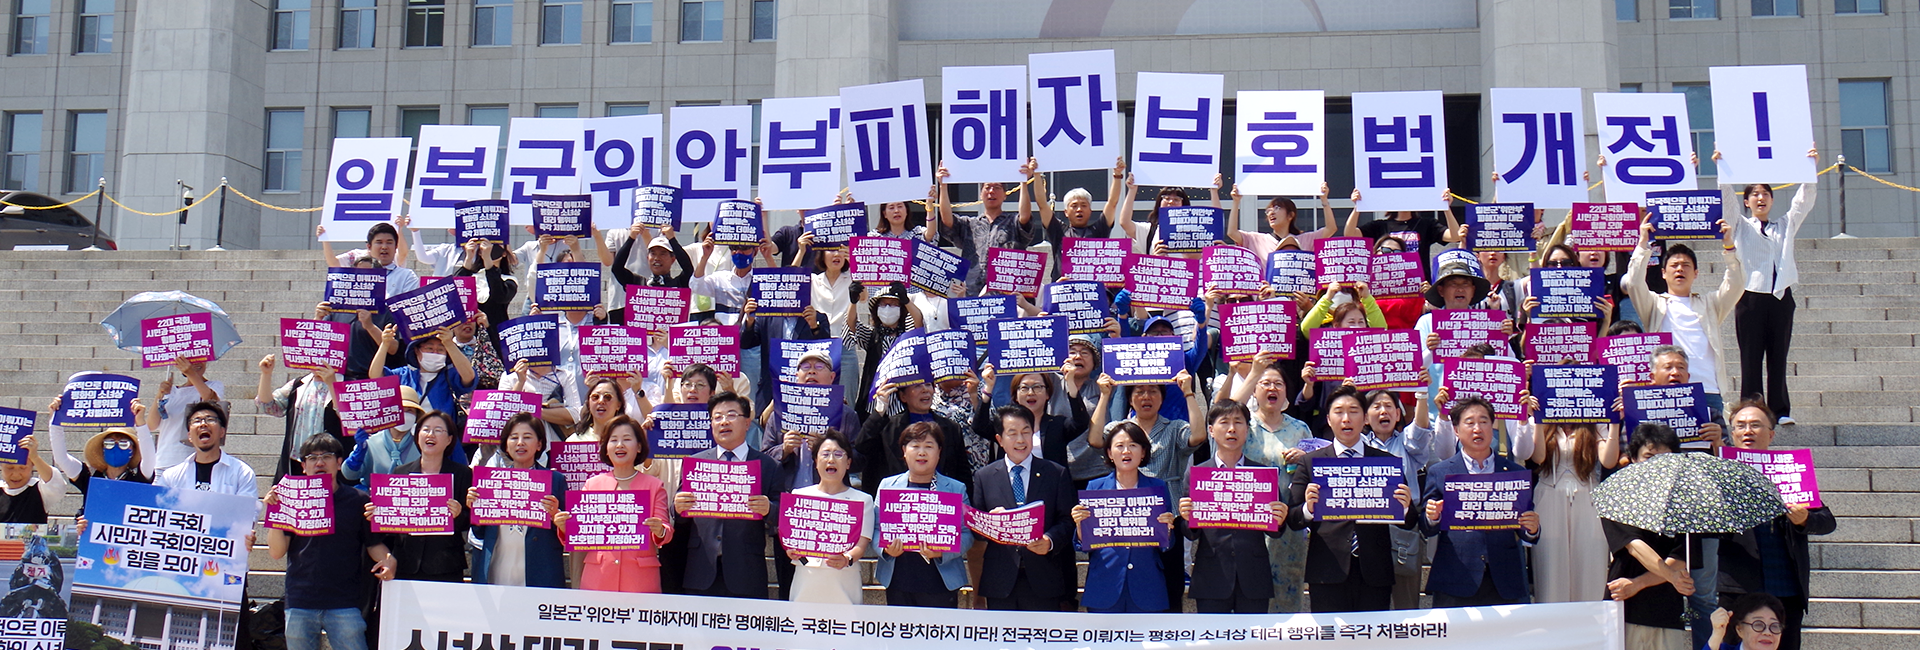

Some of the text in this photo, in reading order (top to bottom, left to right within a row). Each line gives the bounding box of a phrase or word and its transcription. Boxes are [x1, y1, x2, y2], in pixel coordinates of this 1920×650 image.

[389, 477, 431, 487] 22대 국회,
[1211, 471, 1256, 482] 22대 국회,
[376, 486, 446, 497] 시민과 국회의원의
[1195, 481, 1272, 492] 시민과 국회의원의
[392, 497, 429, 506] 힘을 모아
[899, 493, 941, 504] 22대 국회,
[1214, 493, 1253, 502] 힘을 모아
[430, 506, 451, 516] 모욕,
[884, 503, 955, 514] 시민과 국회의원의
[128, 508, 206, 534] 22대 국회,
[374, 516, 448, 526] 역사왜곡 막아내자!
[902, 513, 938, 522] 힘을 모아
[1192, 511, 1275, 523] 역사왜곡 막아내자!
[938, 524, 958, 535] 모욕,
[95, 525, 234, 557] 시민과 국회의원의
[127, 550, 198, 574] 힘을 모아
[638, 610, 698, 628] 피해자에
[702, 613, 731, 630] 대한
[736, 614, 798, 635] 명예훼손,
[802, 618, 847, 635] 국회는
[851, 620, 896, 638] 더이상
[900, 622, 959, 640] 방치하지
[964, 626, 998, 642] 마라!
[1002, 627, 1078, 642] 전국적으로
[1083, 630, 1144, 643] 이뤄지는
[1149, 630, 1195, 642] 평화의
[1199, 628, 1246, 642] 소녀상
[1251, 626, 1283, 640] 테러
[1287, 625, 1335, 641] 행위를
[1340, 624, 1372, 638] 즉각
[1377, 622, 1447, 639] 처벌하라!
